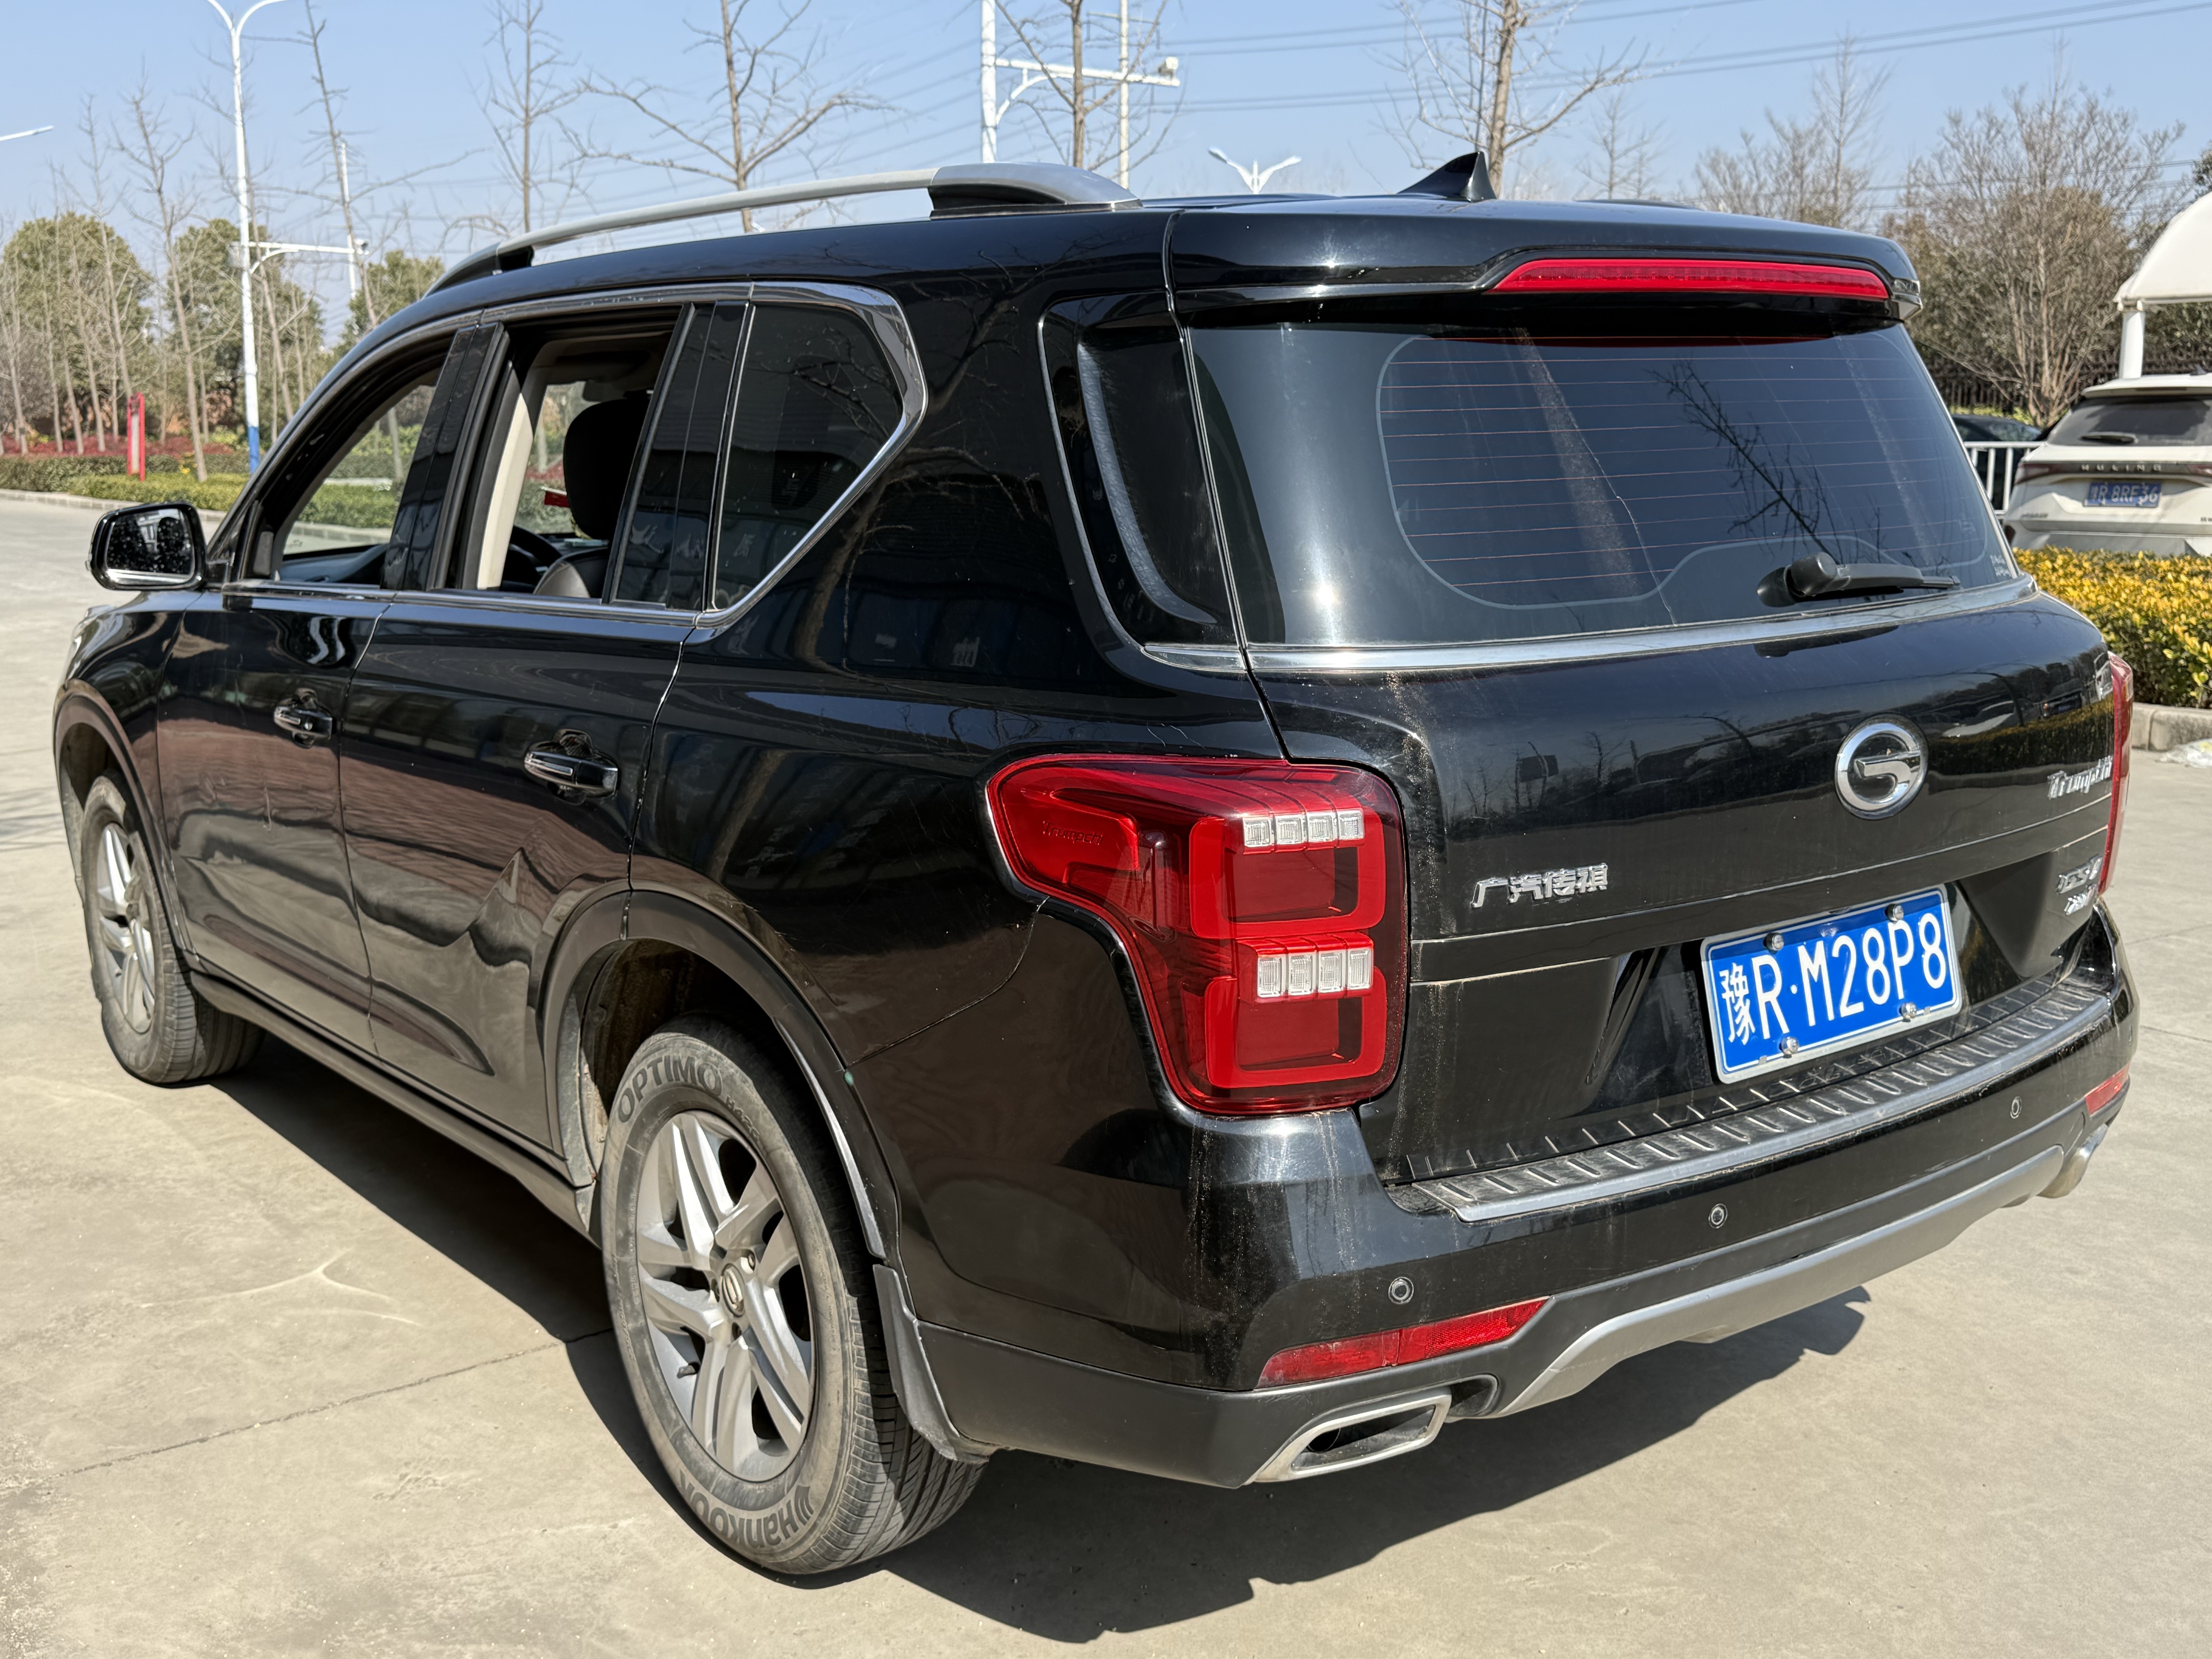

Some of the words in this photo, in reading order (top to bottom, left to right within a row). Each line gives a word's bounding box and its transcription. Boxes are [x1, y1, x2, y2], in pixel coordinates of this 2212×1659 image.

[1470, 862, 1608, 908] 广汽传祺
[618, 1054, 723, 1123] OPTIMO
